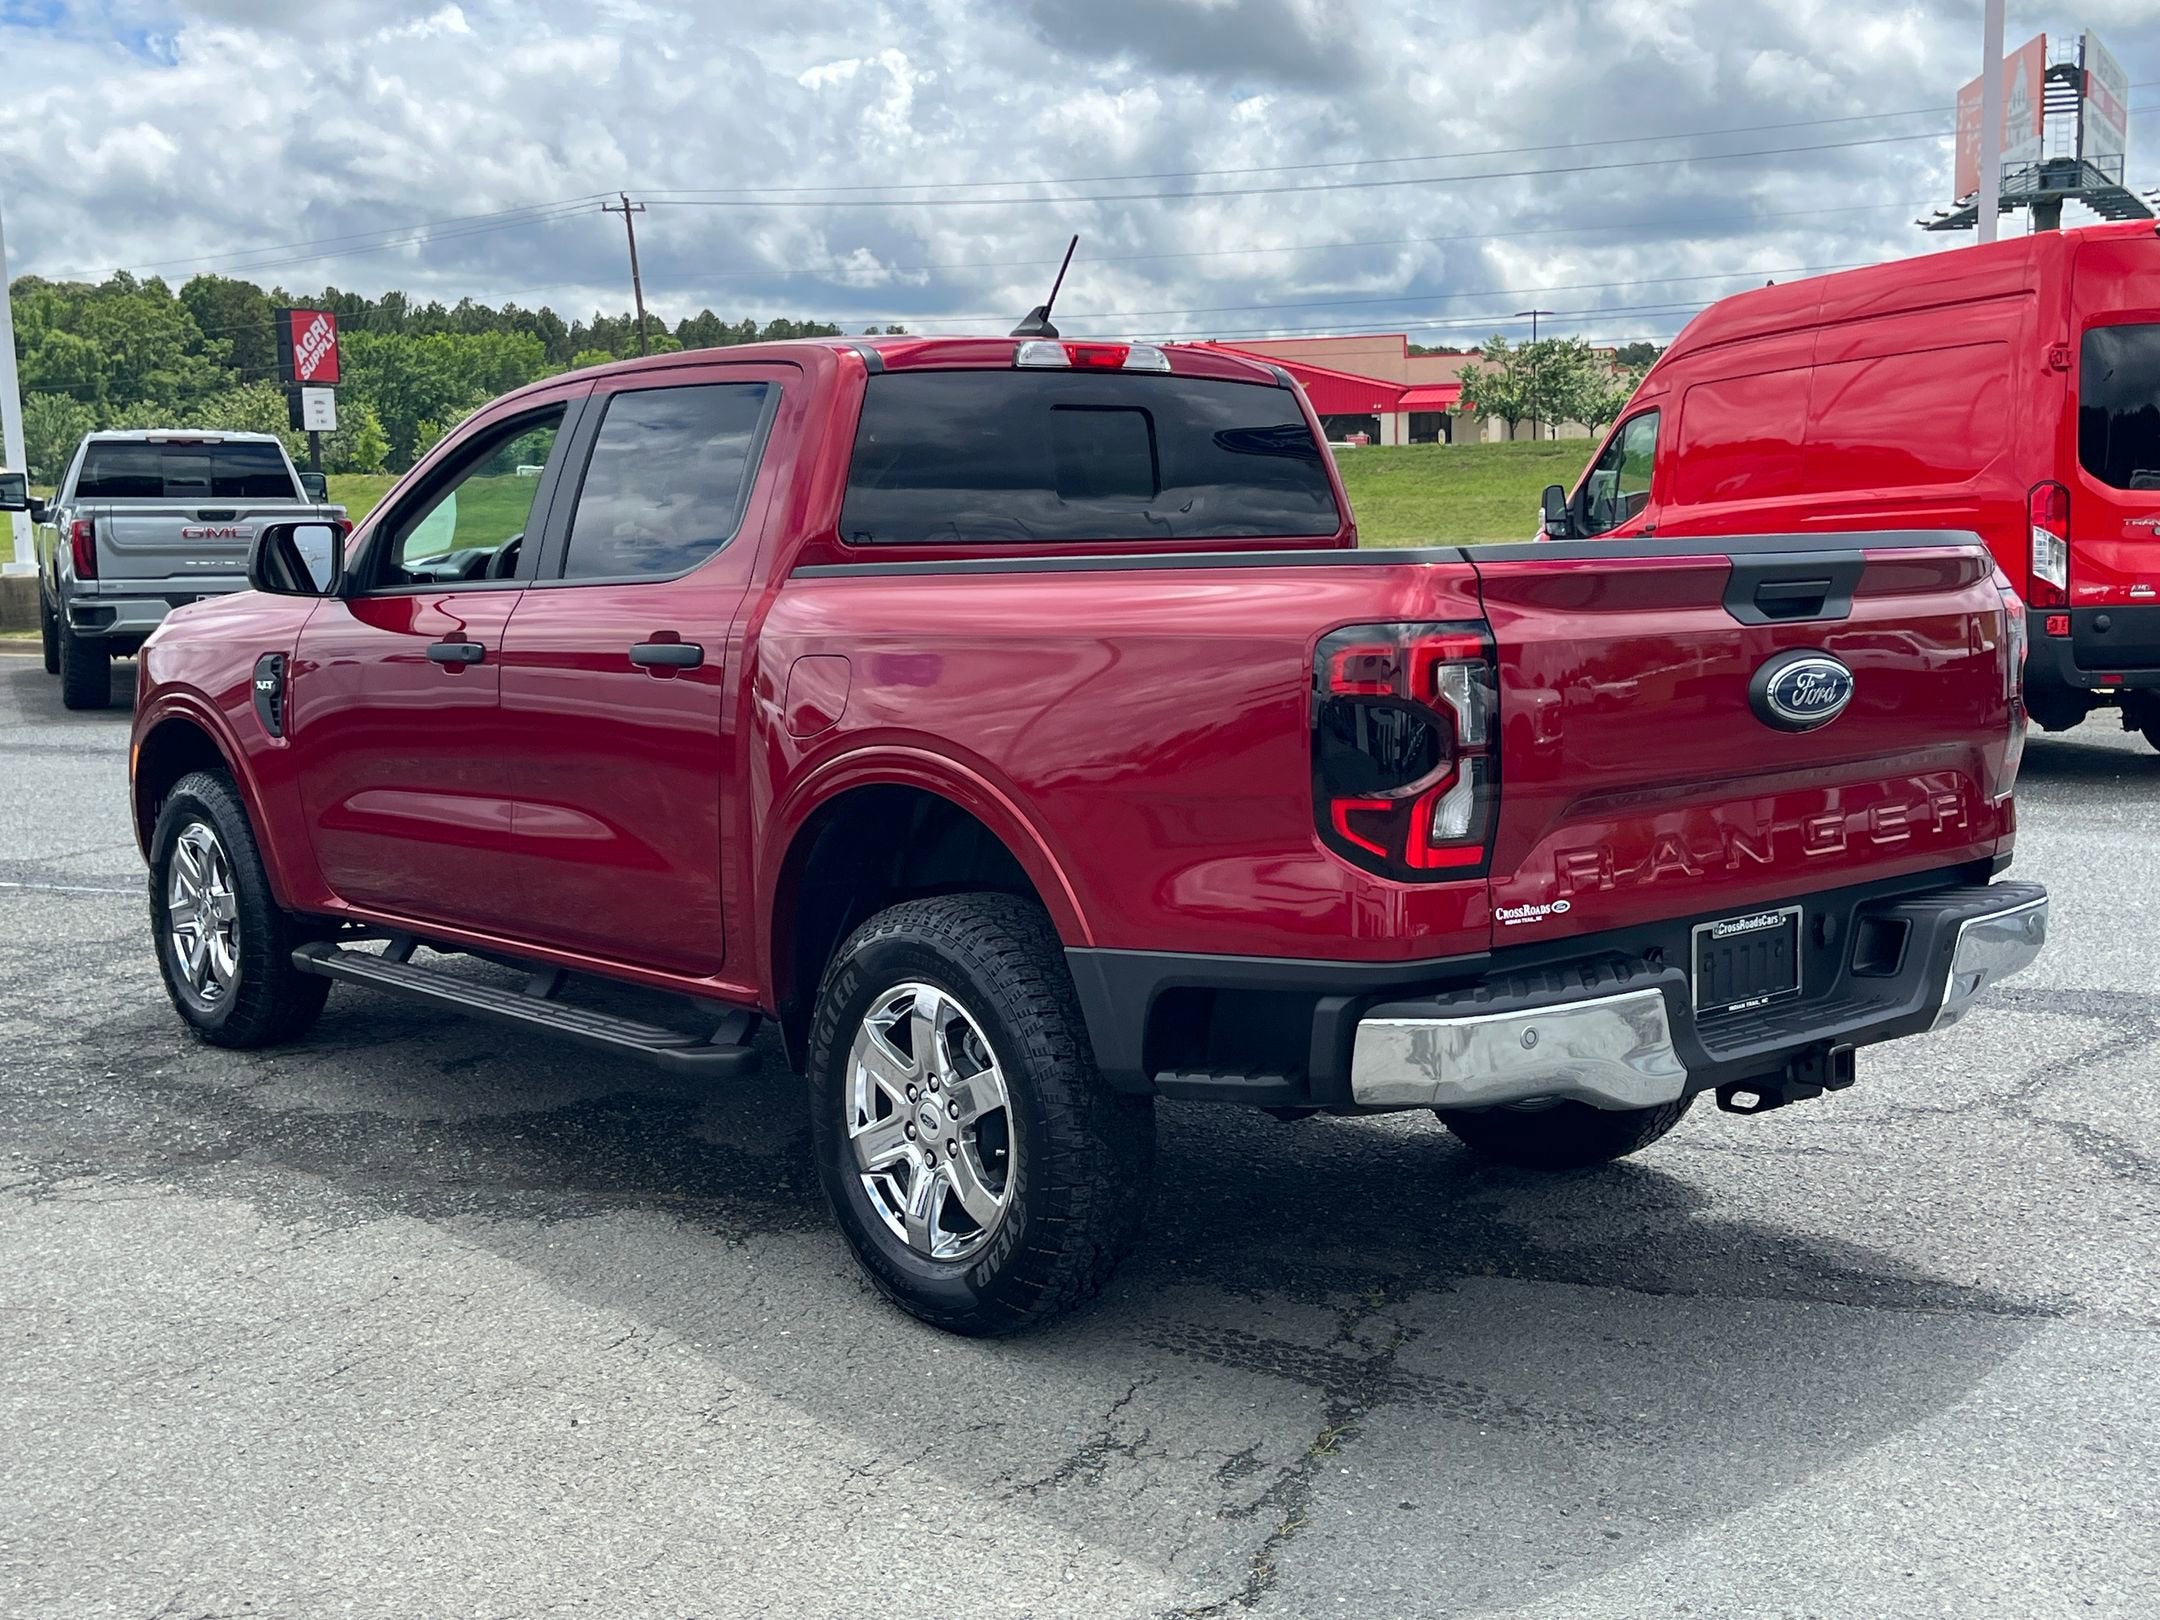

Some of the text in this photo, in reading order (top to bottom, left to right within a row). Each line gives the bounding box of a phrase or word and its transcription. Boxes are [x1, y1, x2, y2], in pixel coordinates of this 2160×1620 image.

[295, 313, 329, 365] AGRI
[300, 326, 336, 381] SUPPLY
[182, 525, 254, 540] GMC
[255, 680, 274, 690] XLT
[1790, 672, 1837, 706] Ford
[1553, 793, 1969, 898] RANGER
